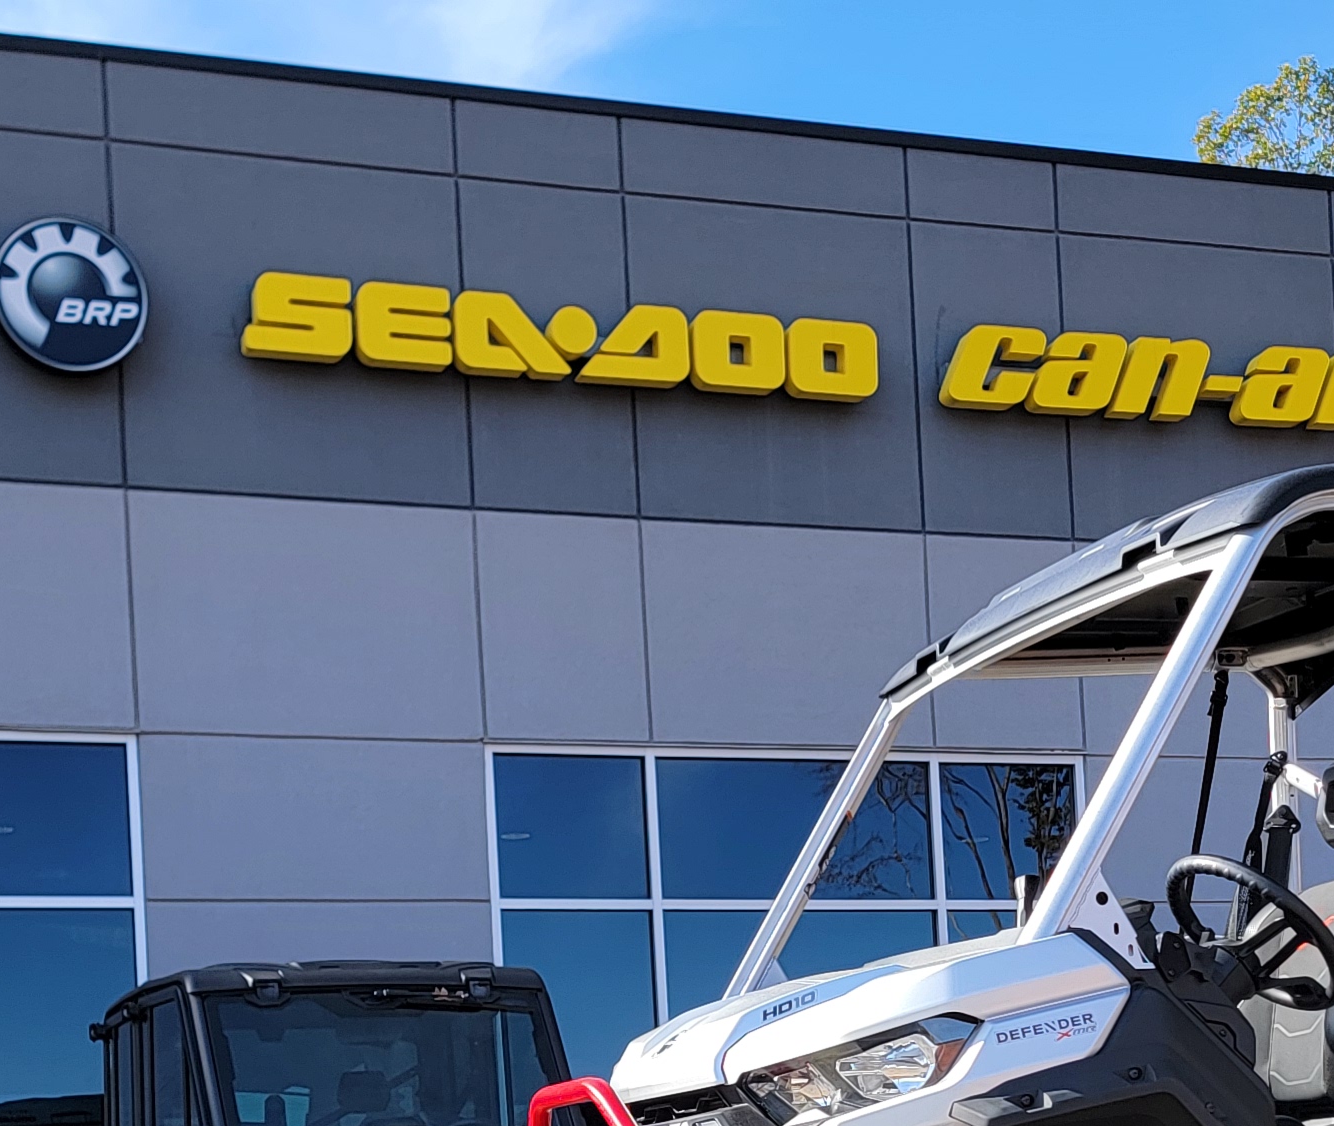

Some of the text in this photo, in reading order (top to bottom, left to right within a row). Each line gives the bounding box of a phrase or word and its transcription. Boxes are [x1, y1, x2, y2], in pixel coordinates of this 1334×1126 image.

[55, 297, 139, 327] BRP
[762, 991, 816, 1022] HD10
[996, 1013, 1094, 1044] DEFENDER
